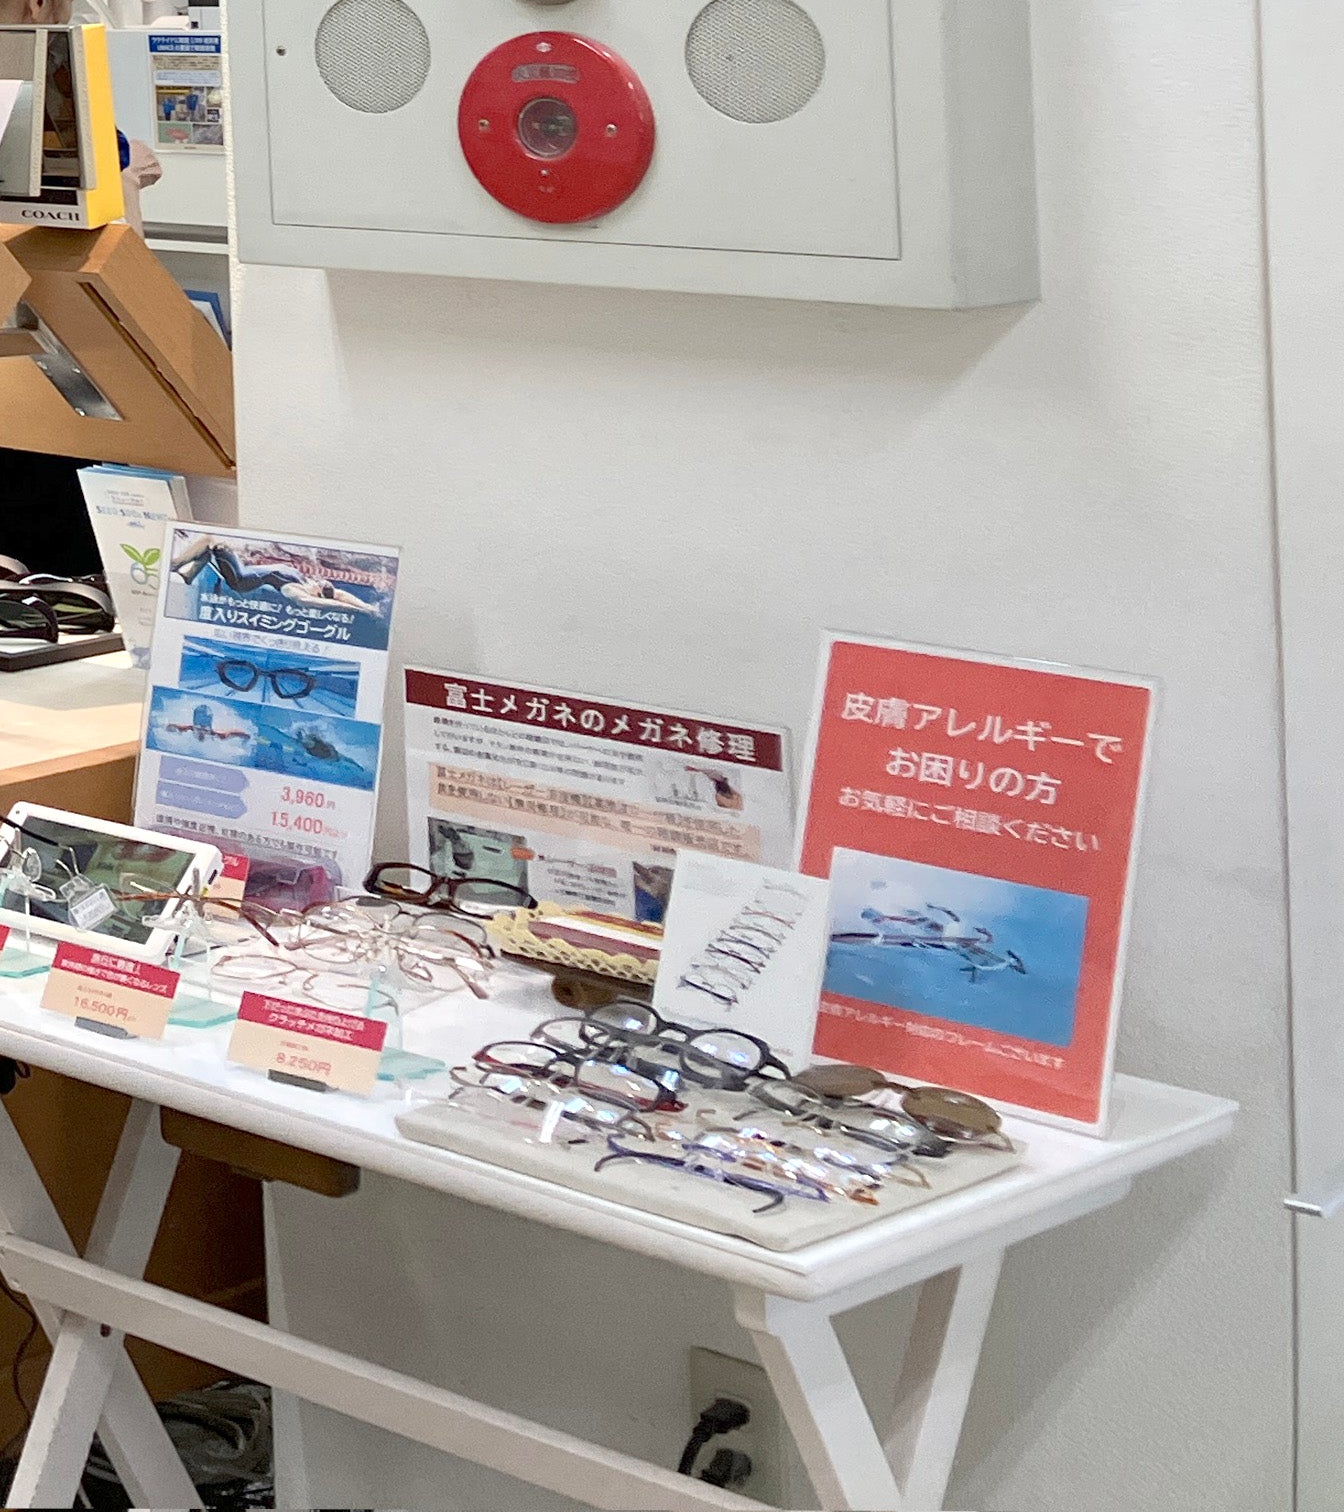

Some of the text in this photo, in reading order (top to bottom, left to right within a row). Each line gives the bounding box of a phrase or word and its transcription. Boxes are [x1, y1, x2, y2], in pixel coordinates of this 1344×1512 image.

[21, 209, 81, 222] COACH
[198, 605, 351, 641] 度入りスイミングゴーグル
[443, 682, 757, 763] 富士メガネのメガネ修理
[840, 690, 1125, 766] 皮膚アレルギーで
[885, 745, 1064, 807] お困りの方
[837, 786, 1102, 854] お気軽にご相談ください
